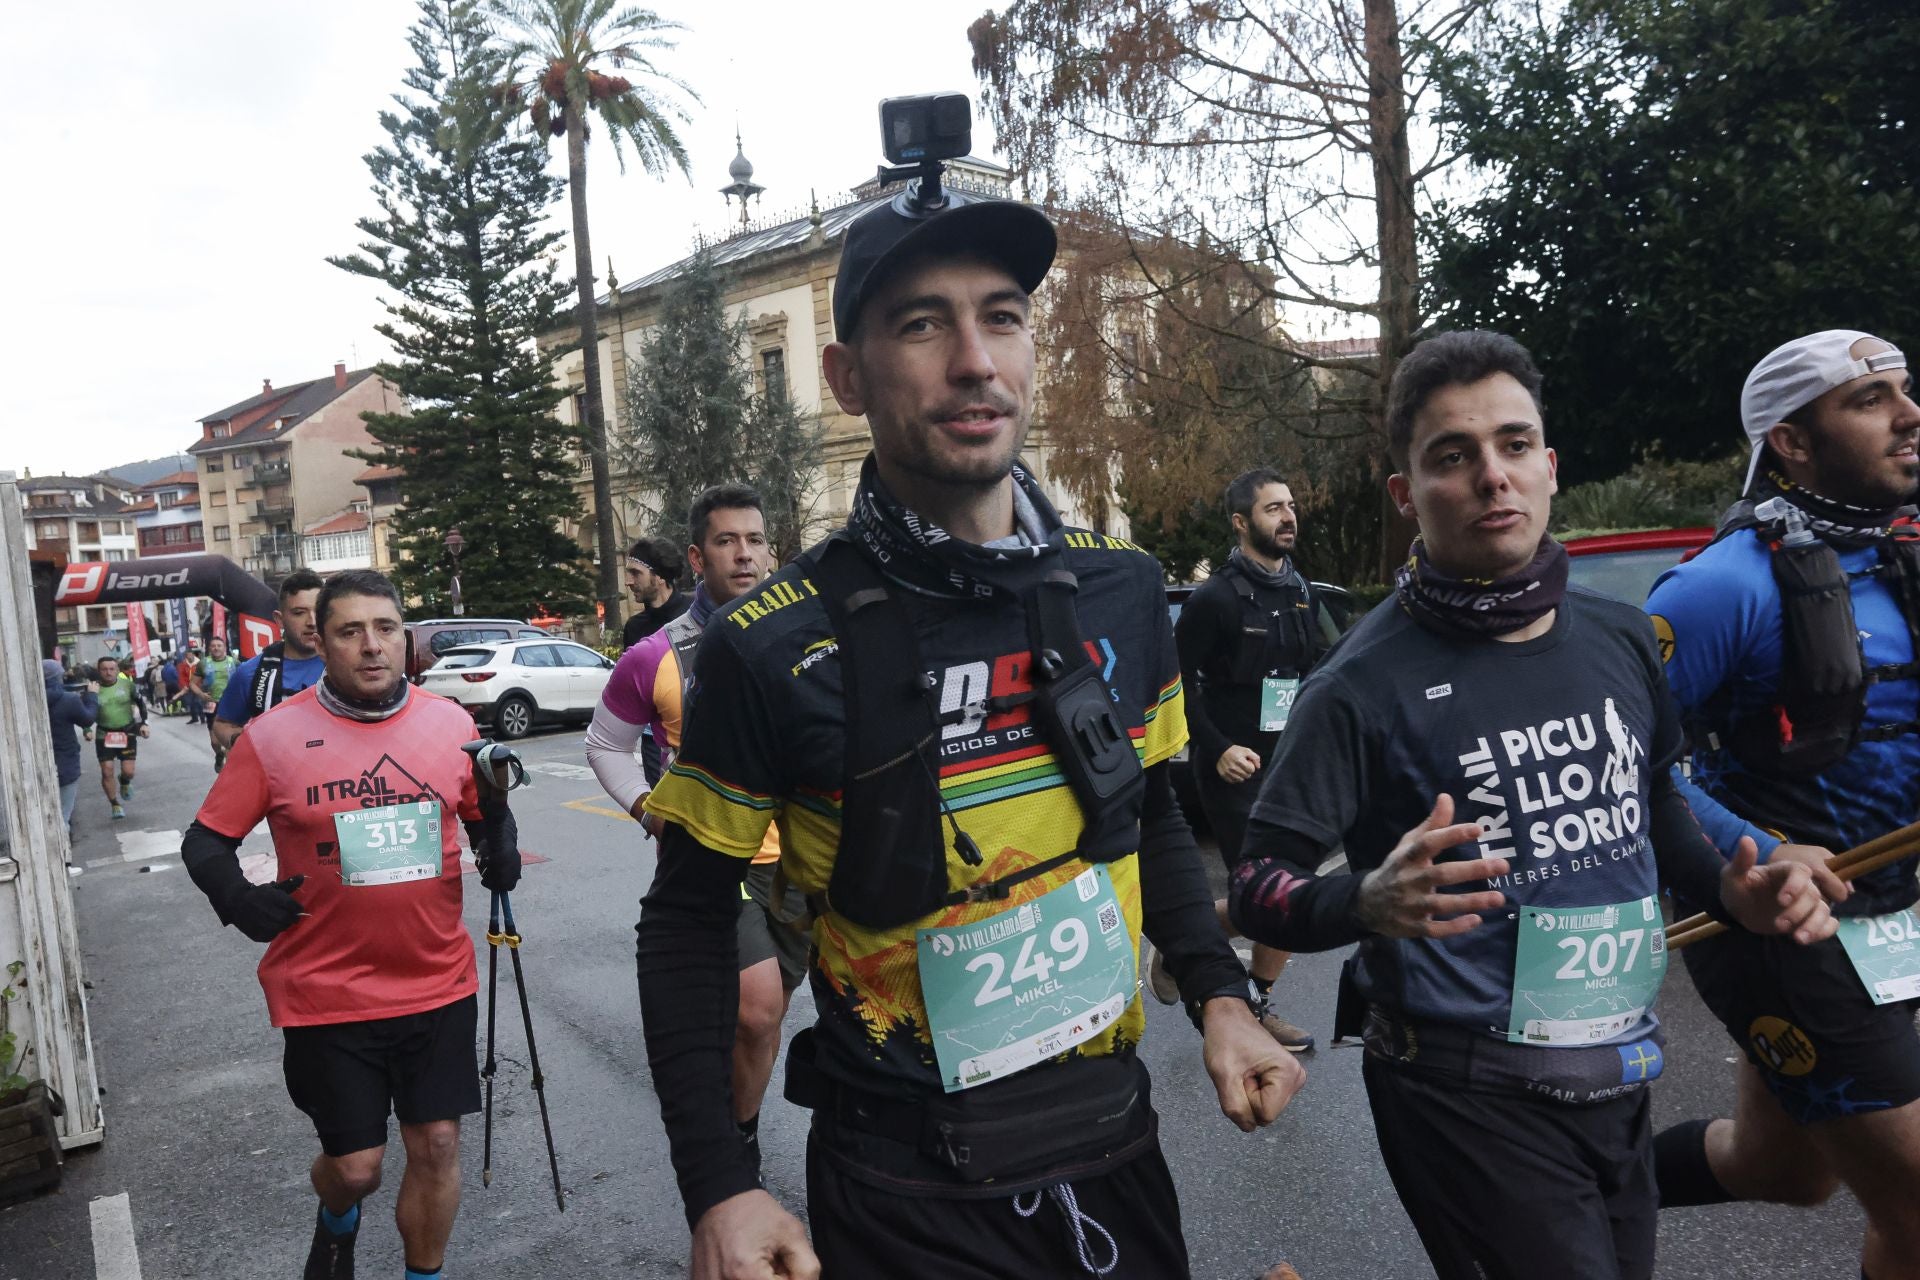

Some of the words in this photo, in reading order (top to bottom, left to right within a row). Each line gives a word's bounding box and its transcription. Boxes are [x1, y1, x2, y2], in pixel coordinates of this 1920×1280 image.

[106, 567, 189, 590] land
[727, 581, 805, 630] TRAIL
[1275, 689, 1298, 707] 20
[1428, 685, 1450, 698] 42K
[1006, 726, 1035, 741] DE
[1500, 713, 1597, 767] PICU
[306, 785, 320, 806] II
[321, 776, 396, 802] TRAIL
[1458, 737, 1518, 860] TRAIL
[1515, 763, 1593, 814] LLO
[364, 819, 418, 848] 313
[1529, 797, 1641, 859] SORIO
[379, 845, 409, 854] DANIEL
[1487, 864, 1561, 890] MIERES
[1571, 855, 1602, 873] DEL
[956, 934, 972, 951] XI
[972, 914, 1023, 949] VILLACABRA
[1557, 915, 1570, 930] XI
[964, 917, 1090, 1008] 249
[1555, 928, 1645, 980] 207
[1014, 978, 1064, 1007] MIKEL
[1585, 975, 1618, 991] MIGUI
[1524, 1079, 1578, 1103] TRAIL
